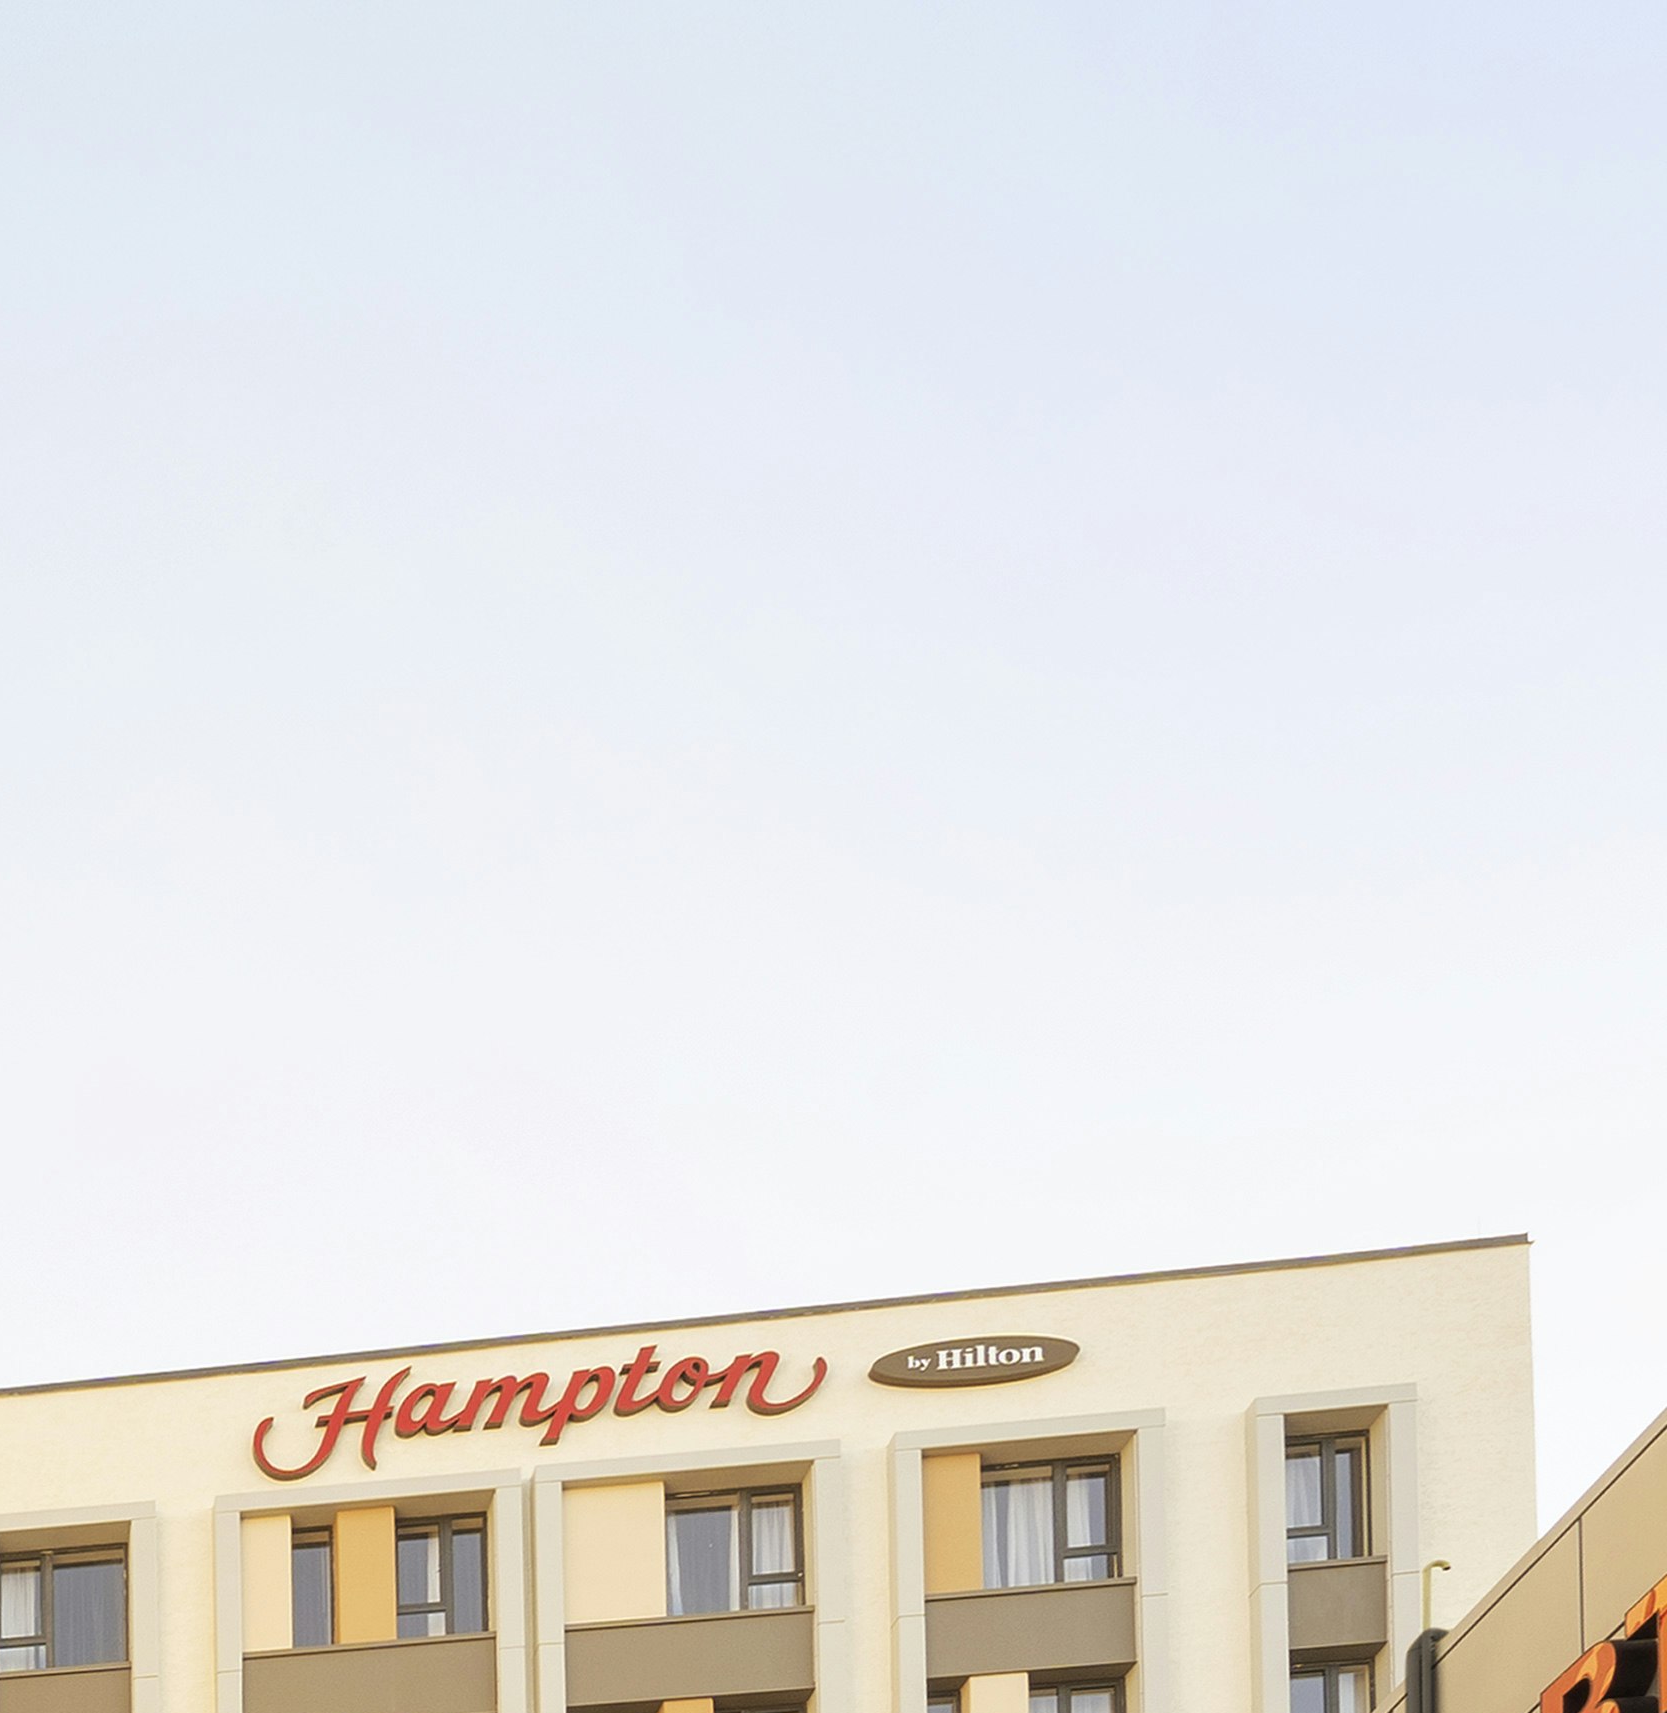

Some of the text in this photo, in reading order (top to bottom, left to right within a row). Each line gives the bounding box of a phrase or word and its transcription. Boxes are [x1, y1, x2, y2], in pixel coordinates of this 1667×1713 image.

[253, 1340, 1045, 1482] Hampton by Hilton
